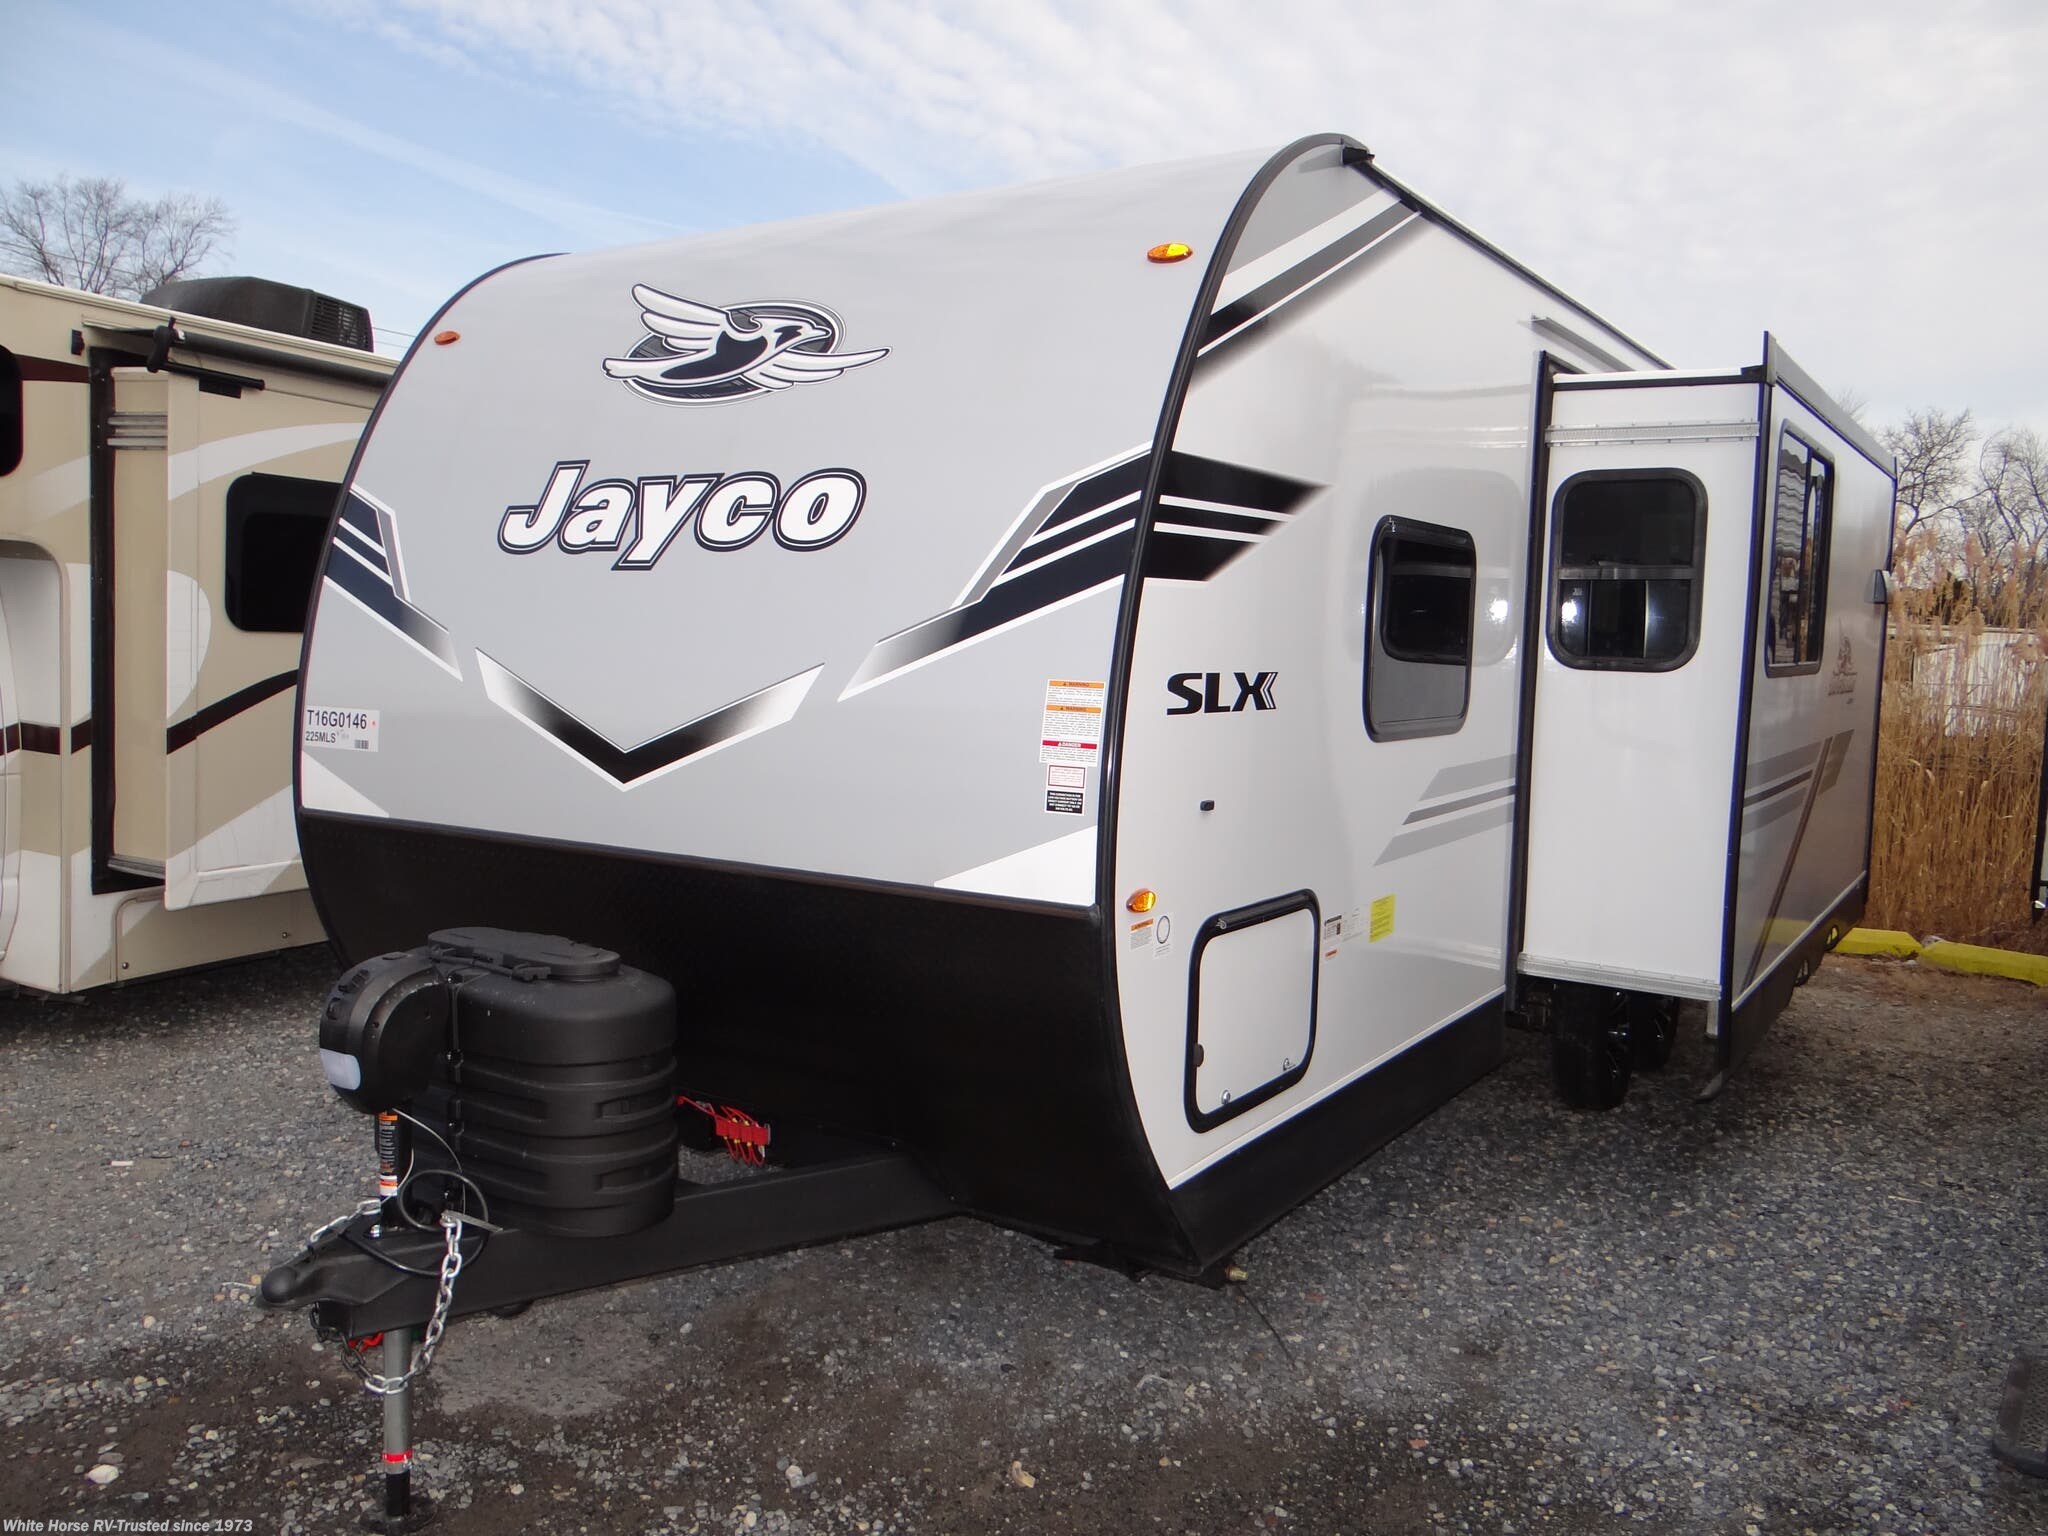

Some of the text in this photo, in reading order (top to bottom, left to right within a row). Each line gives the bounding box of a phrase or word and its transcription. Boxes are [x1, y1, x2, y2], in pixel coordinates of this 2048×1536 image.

[497, 459, 867, 571] Jayco
[1166, 671, 1279, 716] SLX
[307, 709, 367, 729] T16G0146
[305, 731, 336, 743] 225MLS
